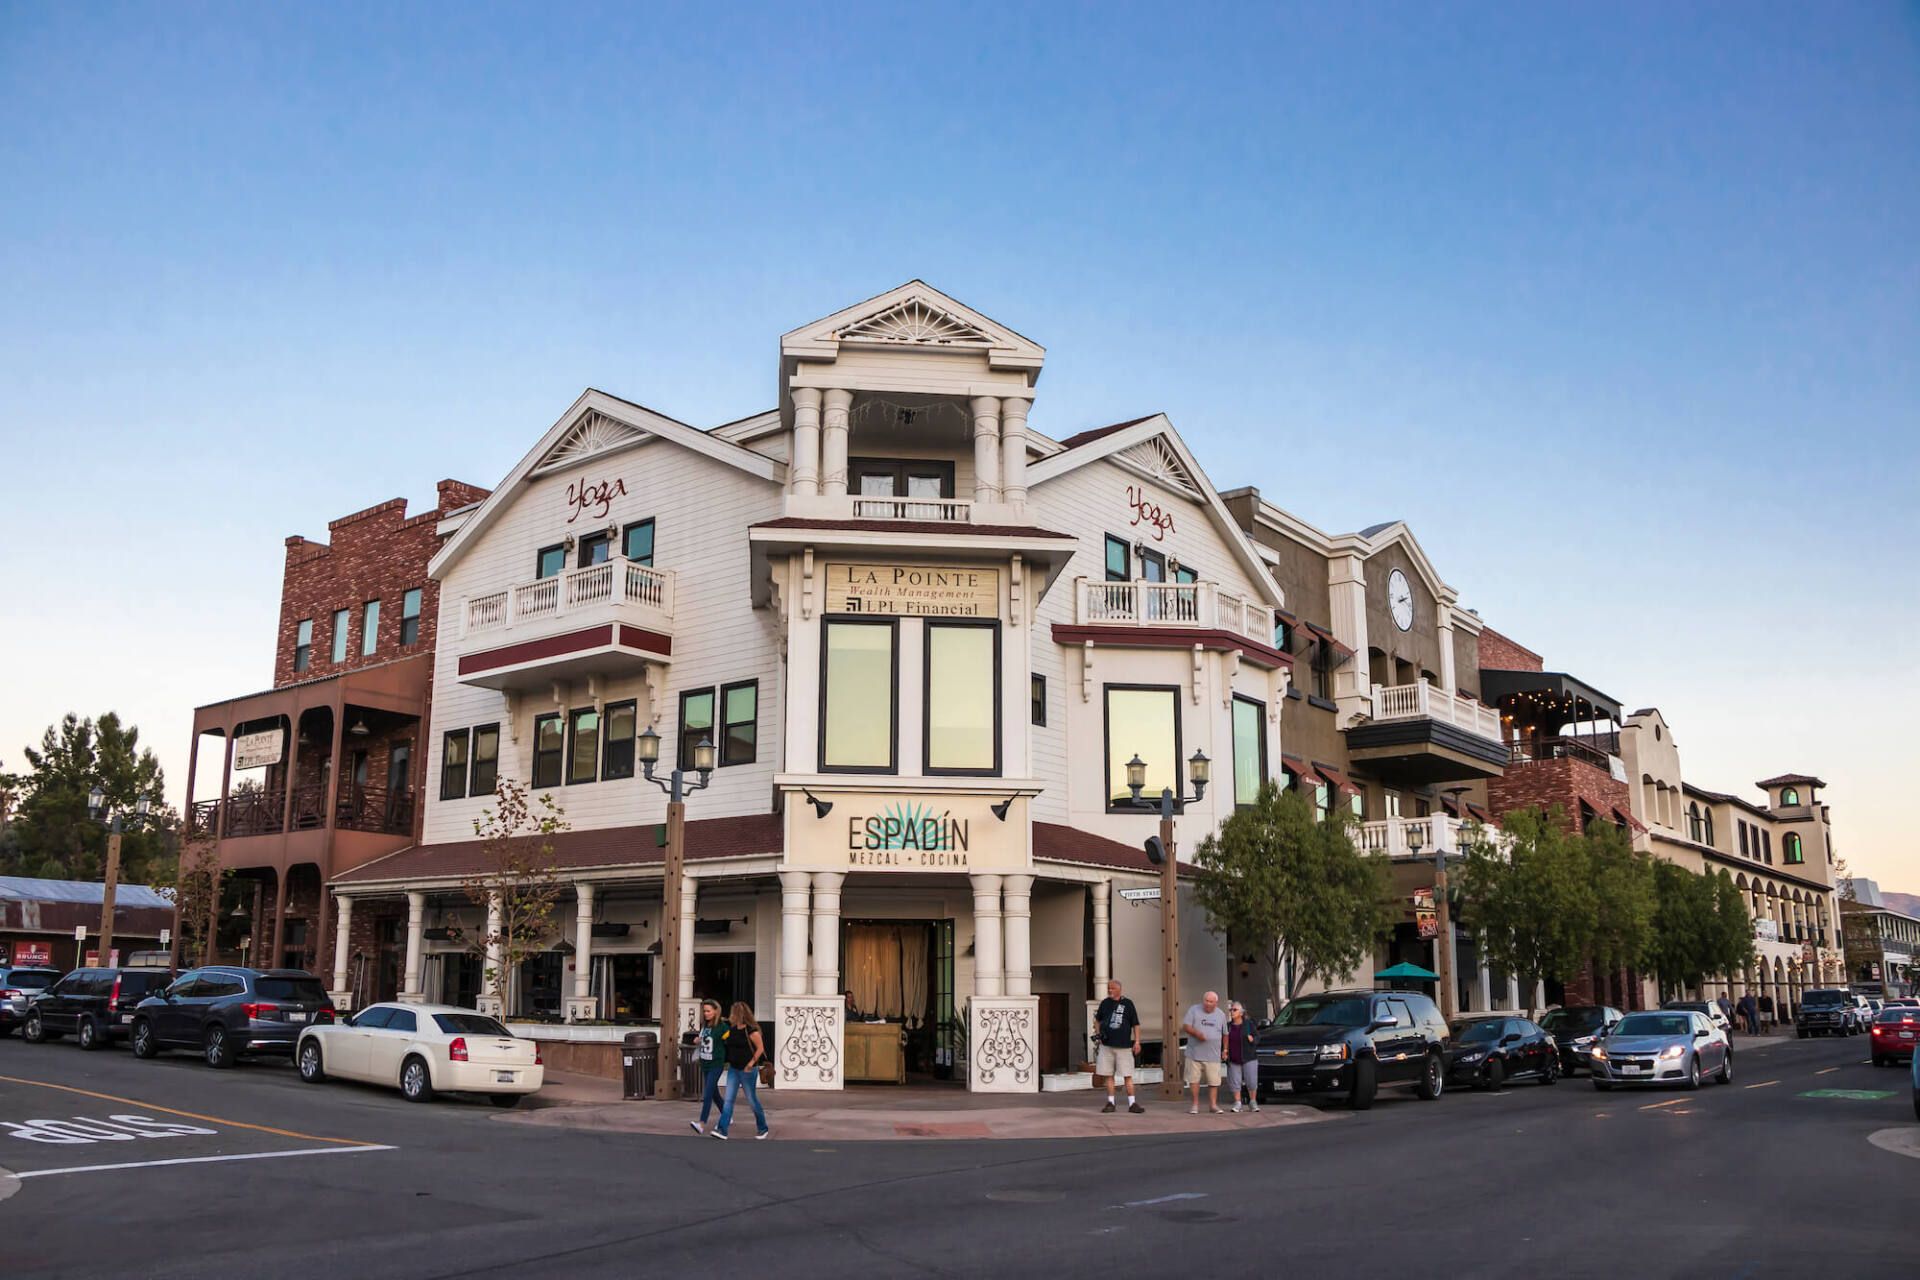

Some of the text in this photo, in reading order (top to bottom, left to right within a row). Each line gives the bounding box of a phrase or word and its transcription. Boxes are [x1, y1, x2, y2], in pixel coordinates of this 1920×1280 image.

[565, 476, 629, 523] Yoga
[1126, 485, 1176, 542] Yoga
[848, 567, 978, 586] LA POINTE
[850, 585, 975, 600] Wealth Management
[867, 600, 978, 616] LPL Financial
[849, 810, 969, 852] ESPADÍN
[849, 851, 968, 866] MEZCAL COCINA
[0, 1114, 218, 1144] STOP
